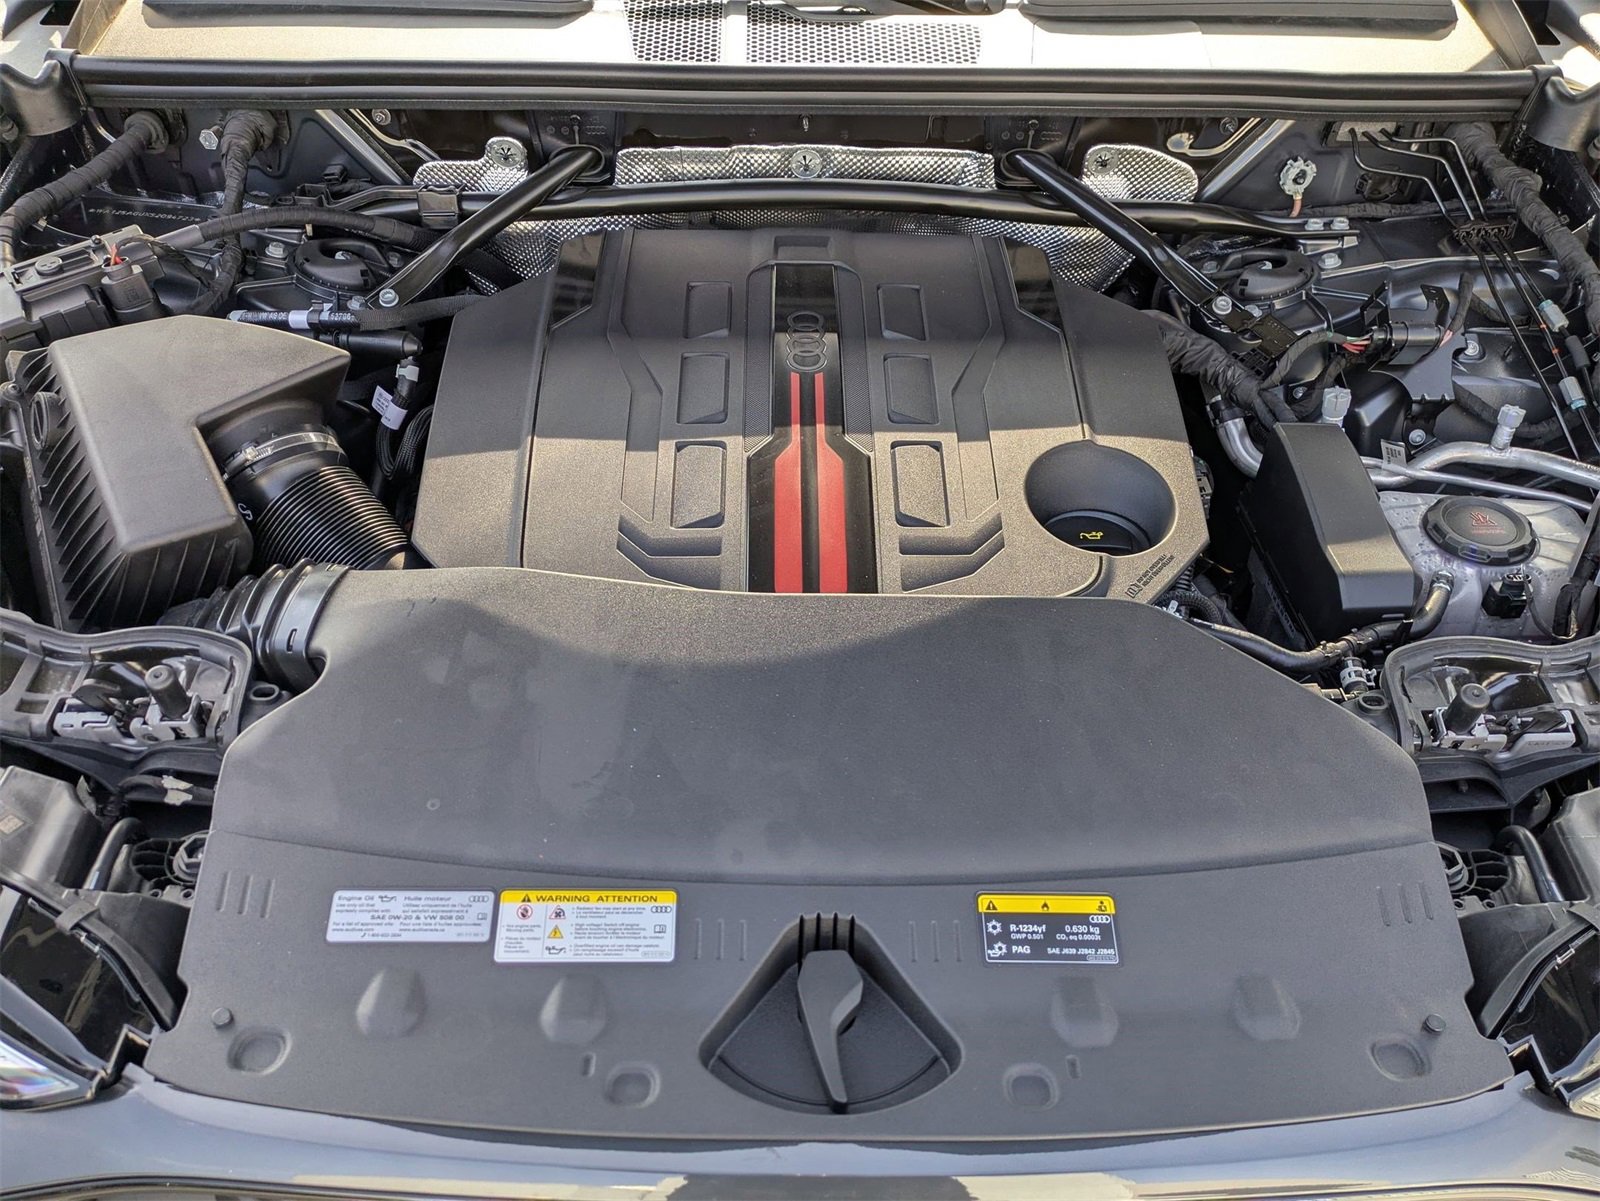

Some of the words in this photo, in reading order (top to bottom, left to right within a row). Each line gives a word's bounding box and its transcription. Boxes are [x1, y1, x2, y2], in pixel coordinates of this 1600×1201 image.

[535, 895, 590, 903] WARNING
[596, 895, 658, 903] ATTENTION
[1009, 924, 1046, 934] R-1234yf
[1064, 924, 1088, 933] 0.630
[1089, 925, 1100, 934] kg
[1012, 945, 1031, 954] PAG
